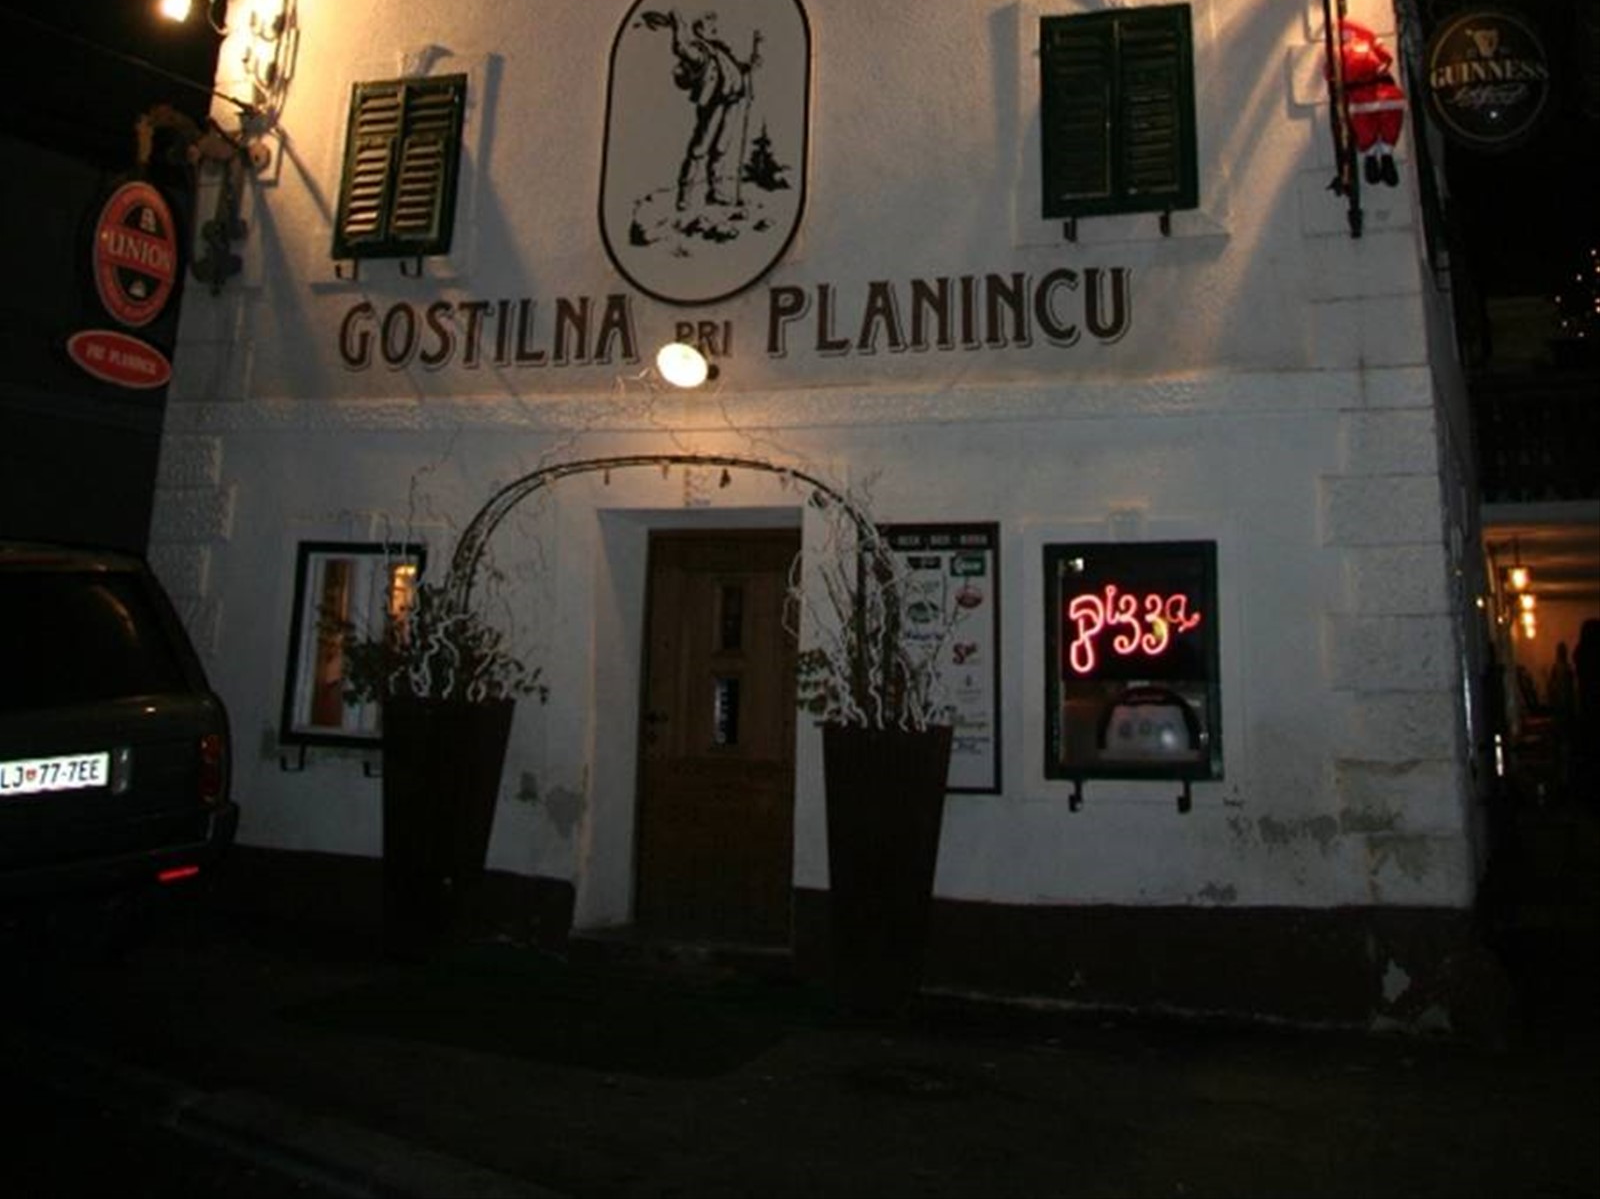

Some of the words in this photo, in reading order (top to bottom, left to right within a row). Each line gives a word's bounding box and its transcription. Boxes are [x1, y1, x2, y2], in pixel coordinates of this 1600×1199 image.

[1430, 57, 1550, 90] GUINNESS
[108, 229, 170, 271] UNION
[338, 293, 640, 372] GOSTILNA
[674, 320, 733, 358] PRI
[766, 266, 1133, 359] PLANINCU
[1069, 584, 1201, 673] pizza
[39, 759, 100, 784] 77-7EE
